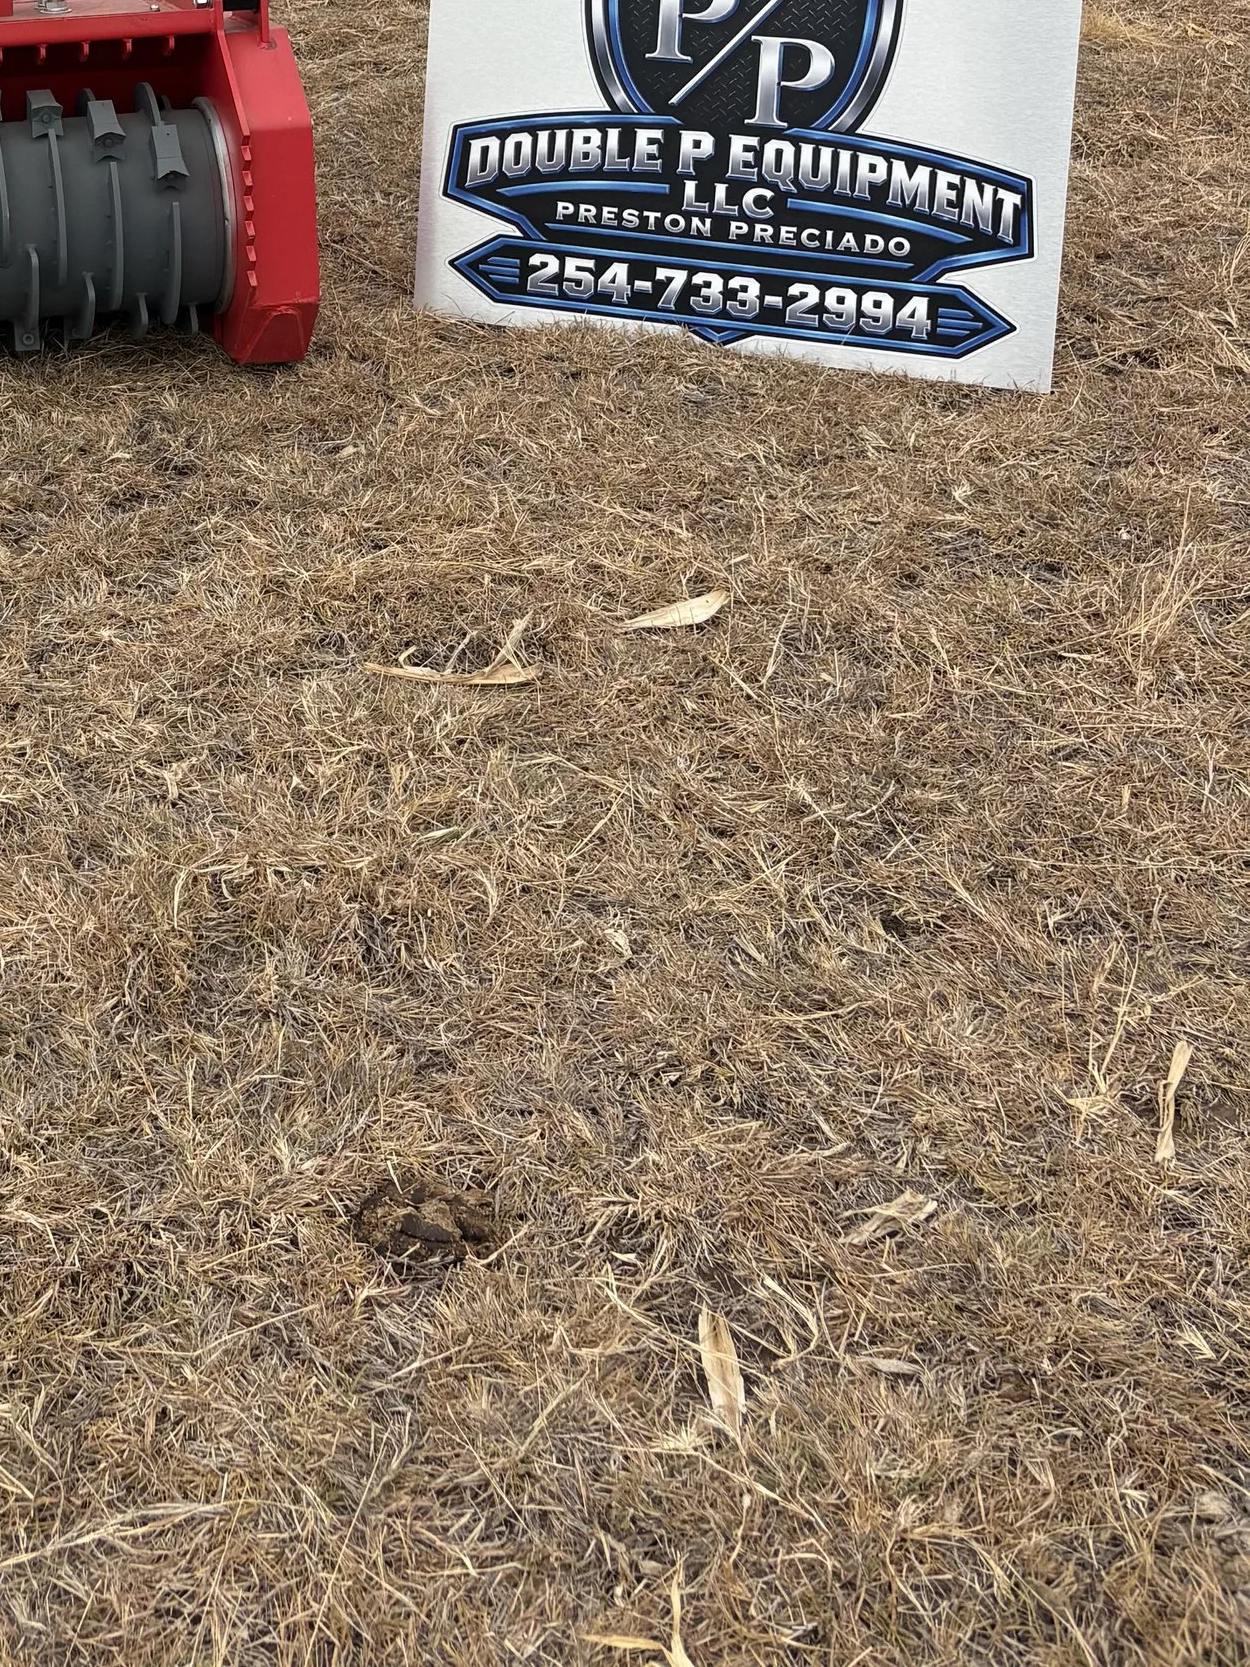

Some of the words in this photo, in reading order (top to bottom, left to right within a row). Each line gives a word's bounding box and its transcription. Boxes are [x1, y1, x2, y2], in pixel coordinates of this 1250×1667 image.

[464, 127, 665, 188] DOUBLE
[676, 130, 716, 175] P
[725, 133, 1023, 245] EQUIPMENT
[681, 179, 776, 219] LLC
[555, 201, 712, 237] PRESTON
[728, 220, 912, 257] PRECIADO
[527, 252, 932, 340] 254-733-2994
